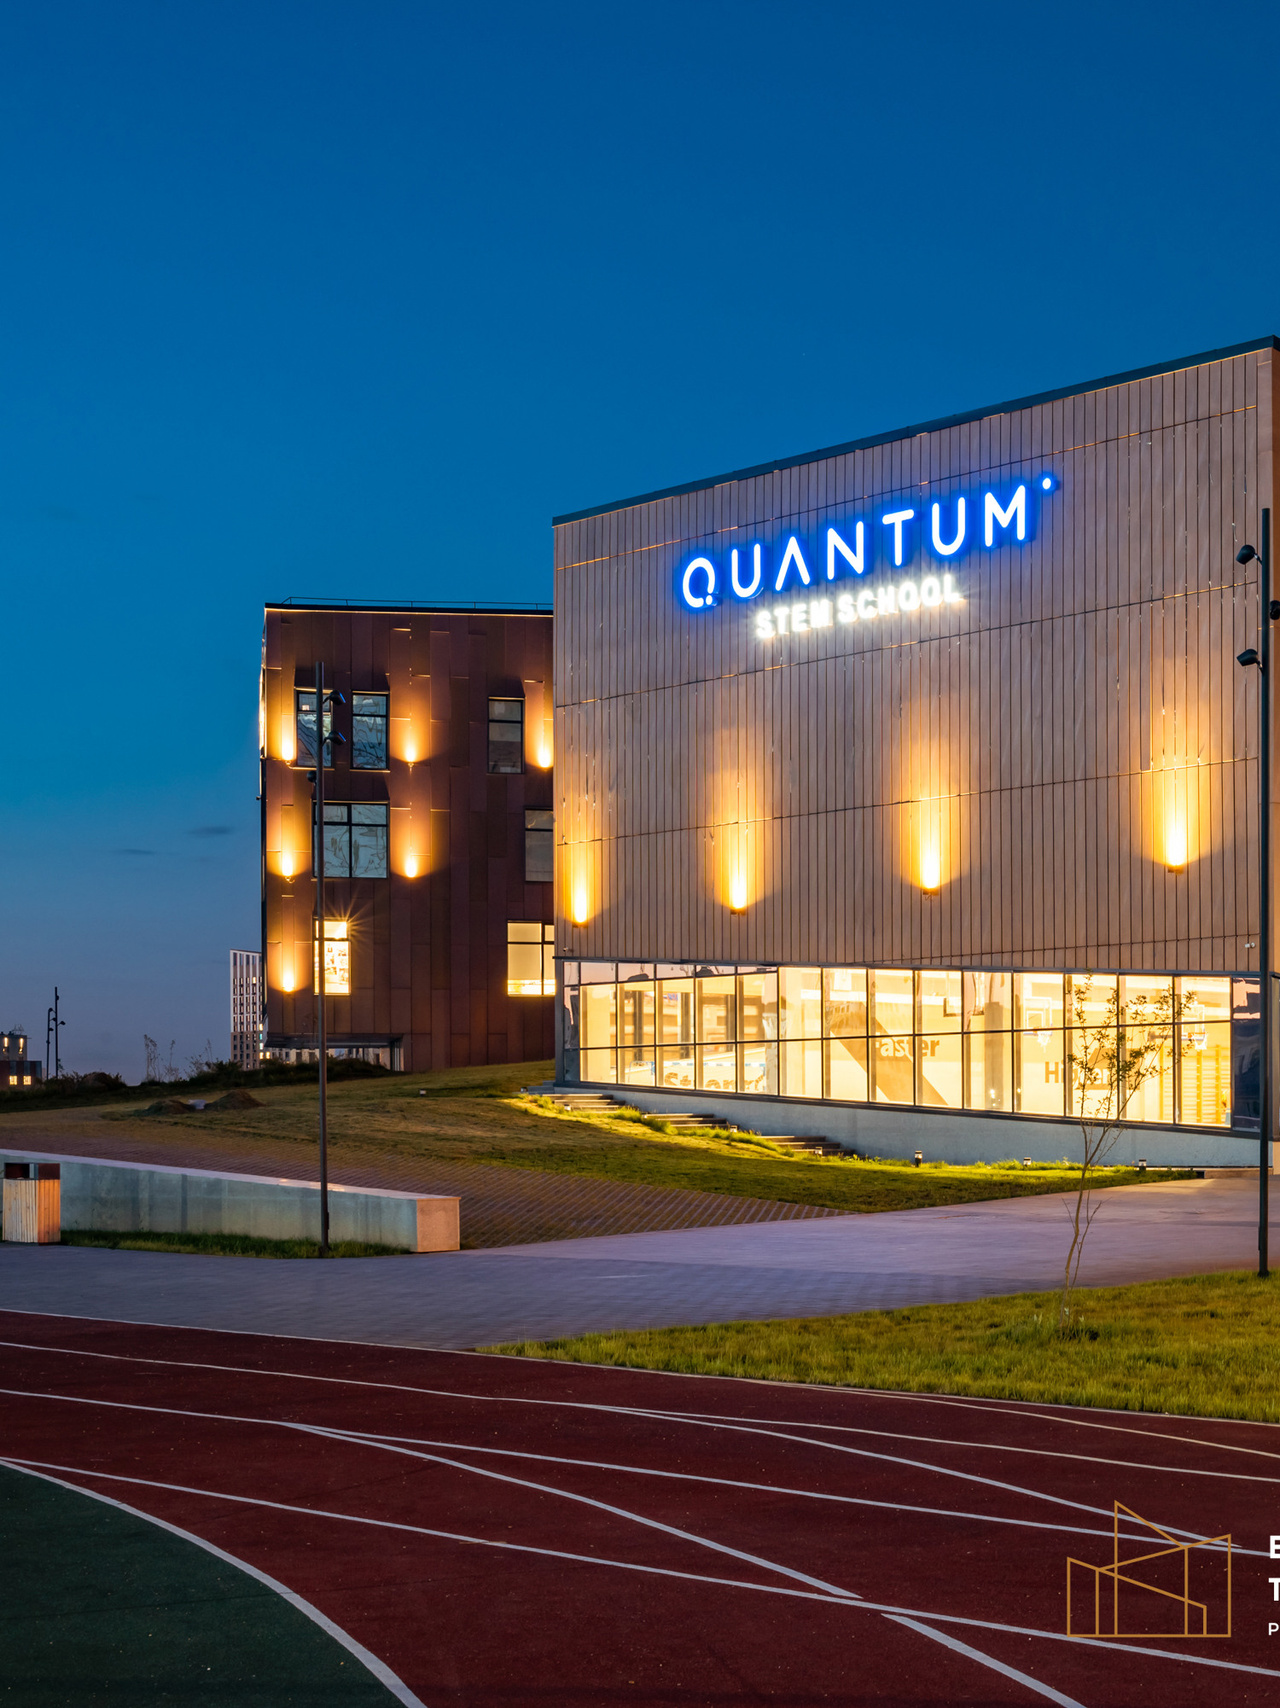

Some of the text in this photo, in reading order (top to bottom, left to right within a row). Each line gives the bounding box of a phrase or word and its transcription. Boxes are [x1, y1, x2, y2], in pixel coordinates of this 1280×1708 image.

[682, 484, 1026, 608] QUANTUM
[756, 573, 965, 639] STEM SCHOOL
